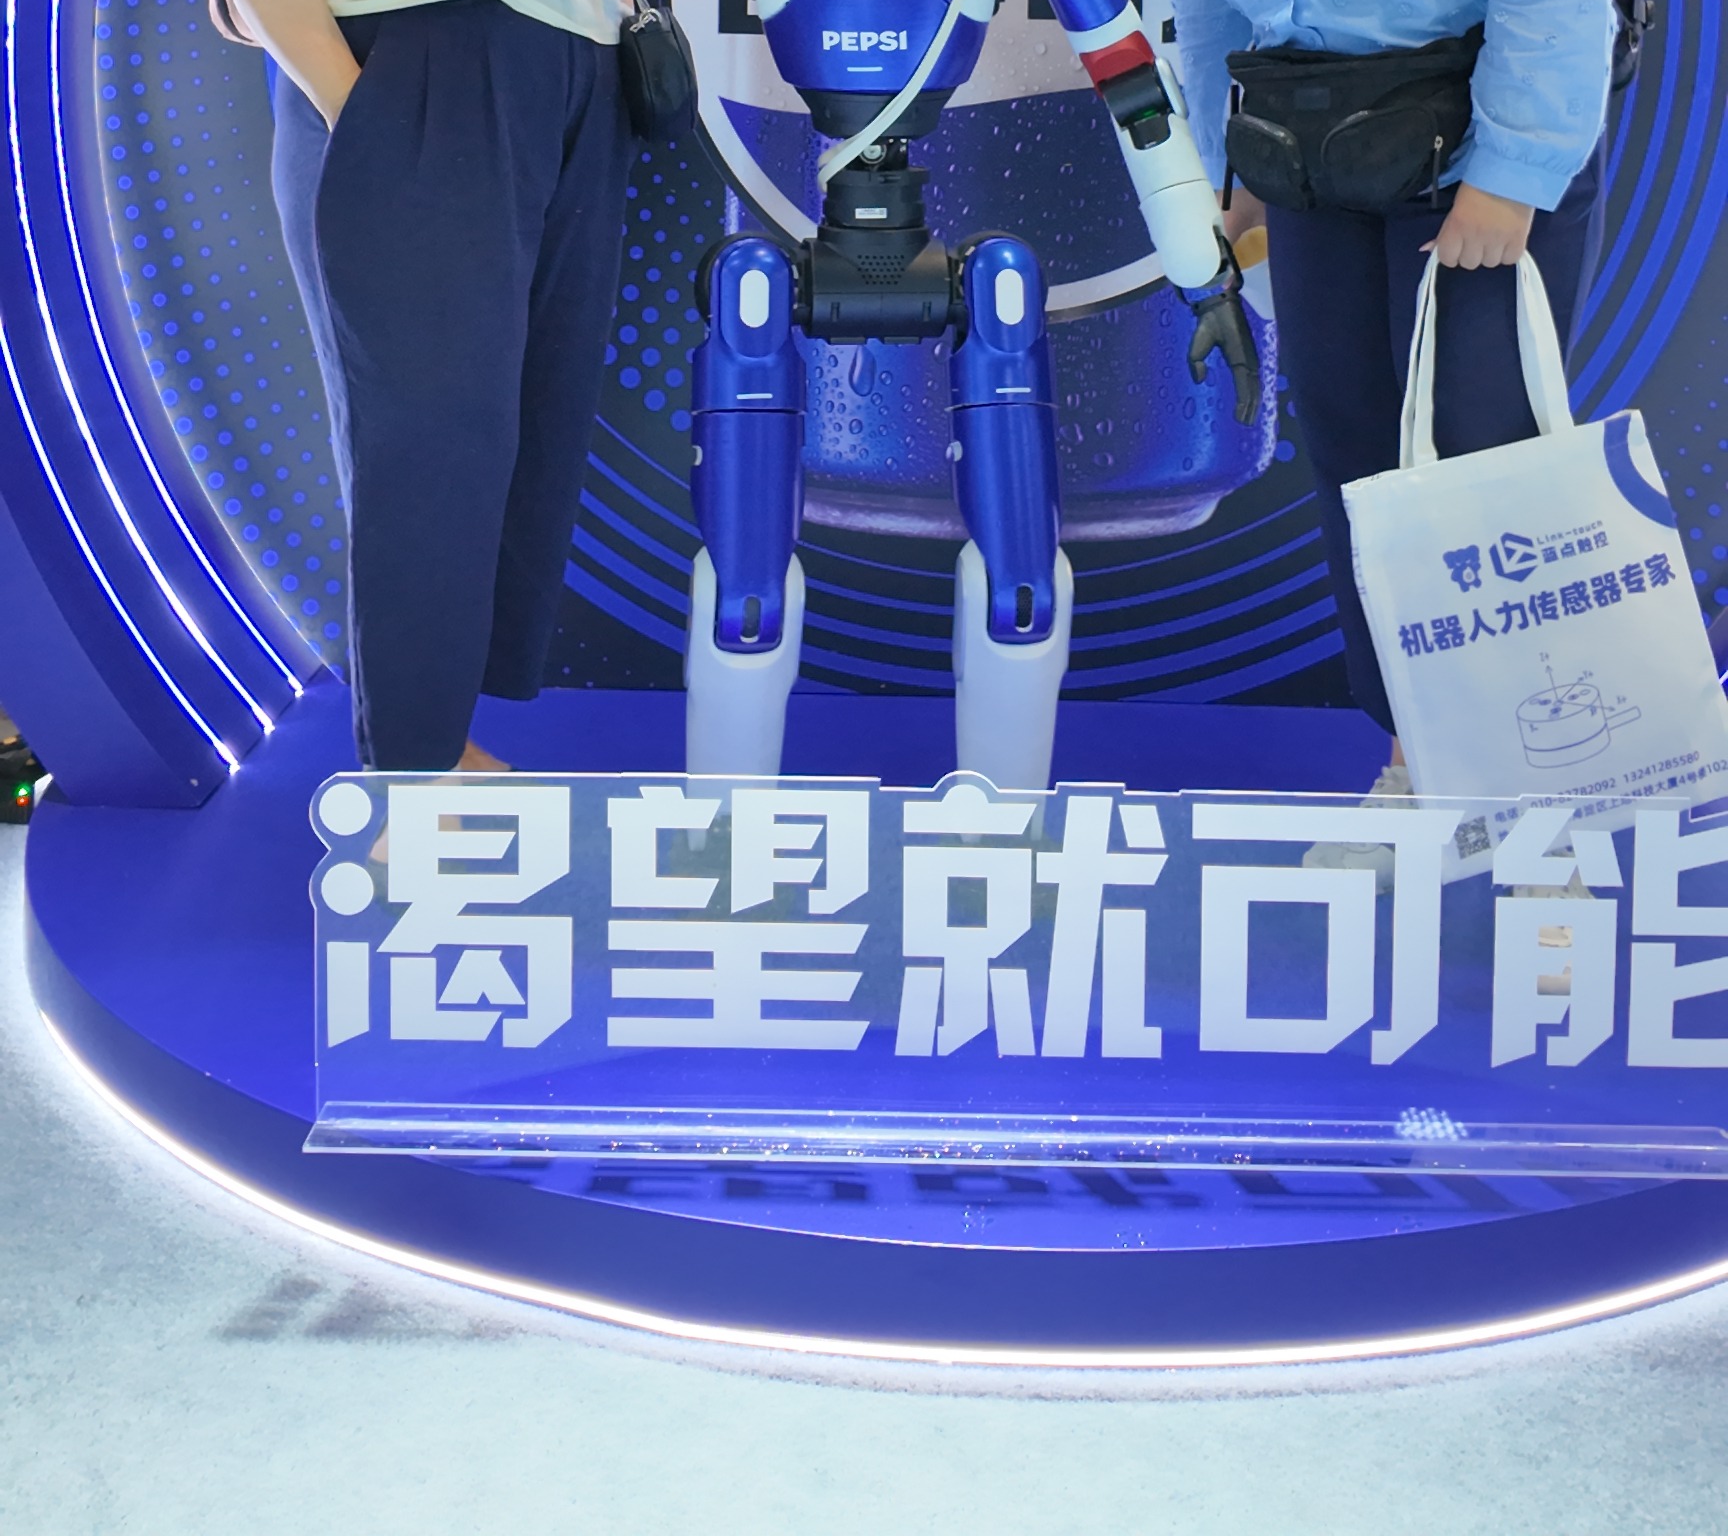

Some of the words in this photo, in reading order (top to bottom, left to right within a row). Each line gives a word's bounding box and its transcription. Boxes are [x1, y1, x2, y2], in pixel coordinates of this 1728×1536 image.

[822, 30, 908, 52] PEPSI
[1541, 530, 1609, 564] 蓝点触控
[1398, 552, 1677, 658] 机器人力传感器专家
[1622, 750, 1700, 784] 13241285580
[318, 782, 1728, 1068] 渴望就可能
